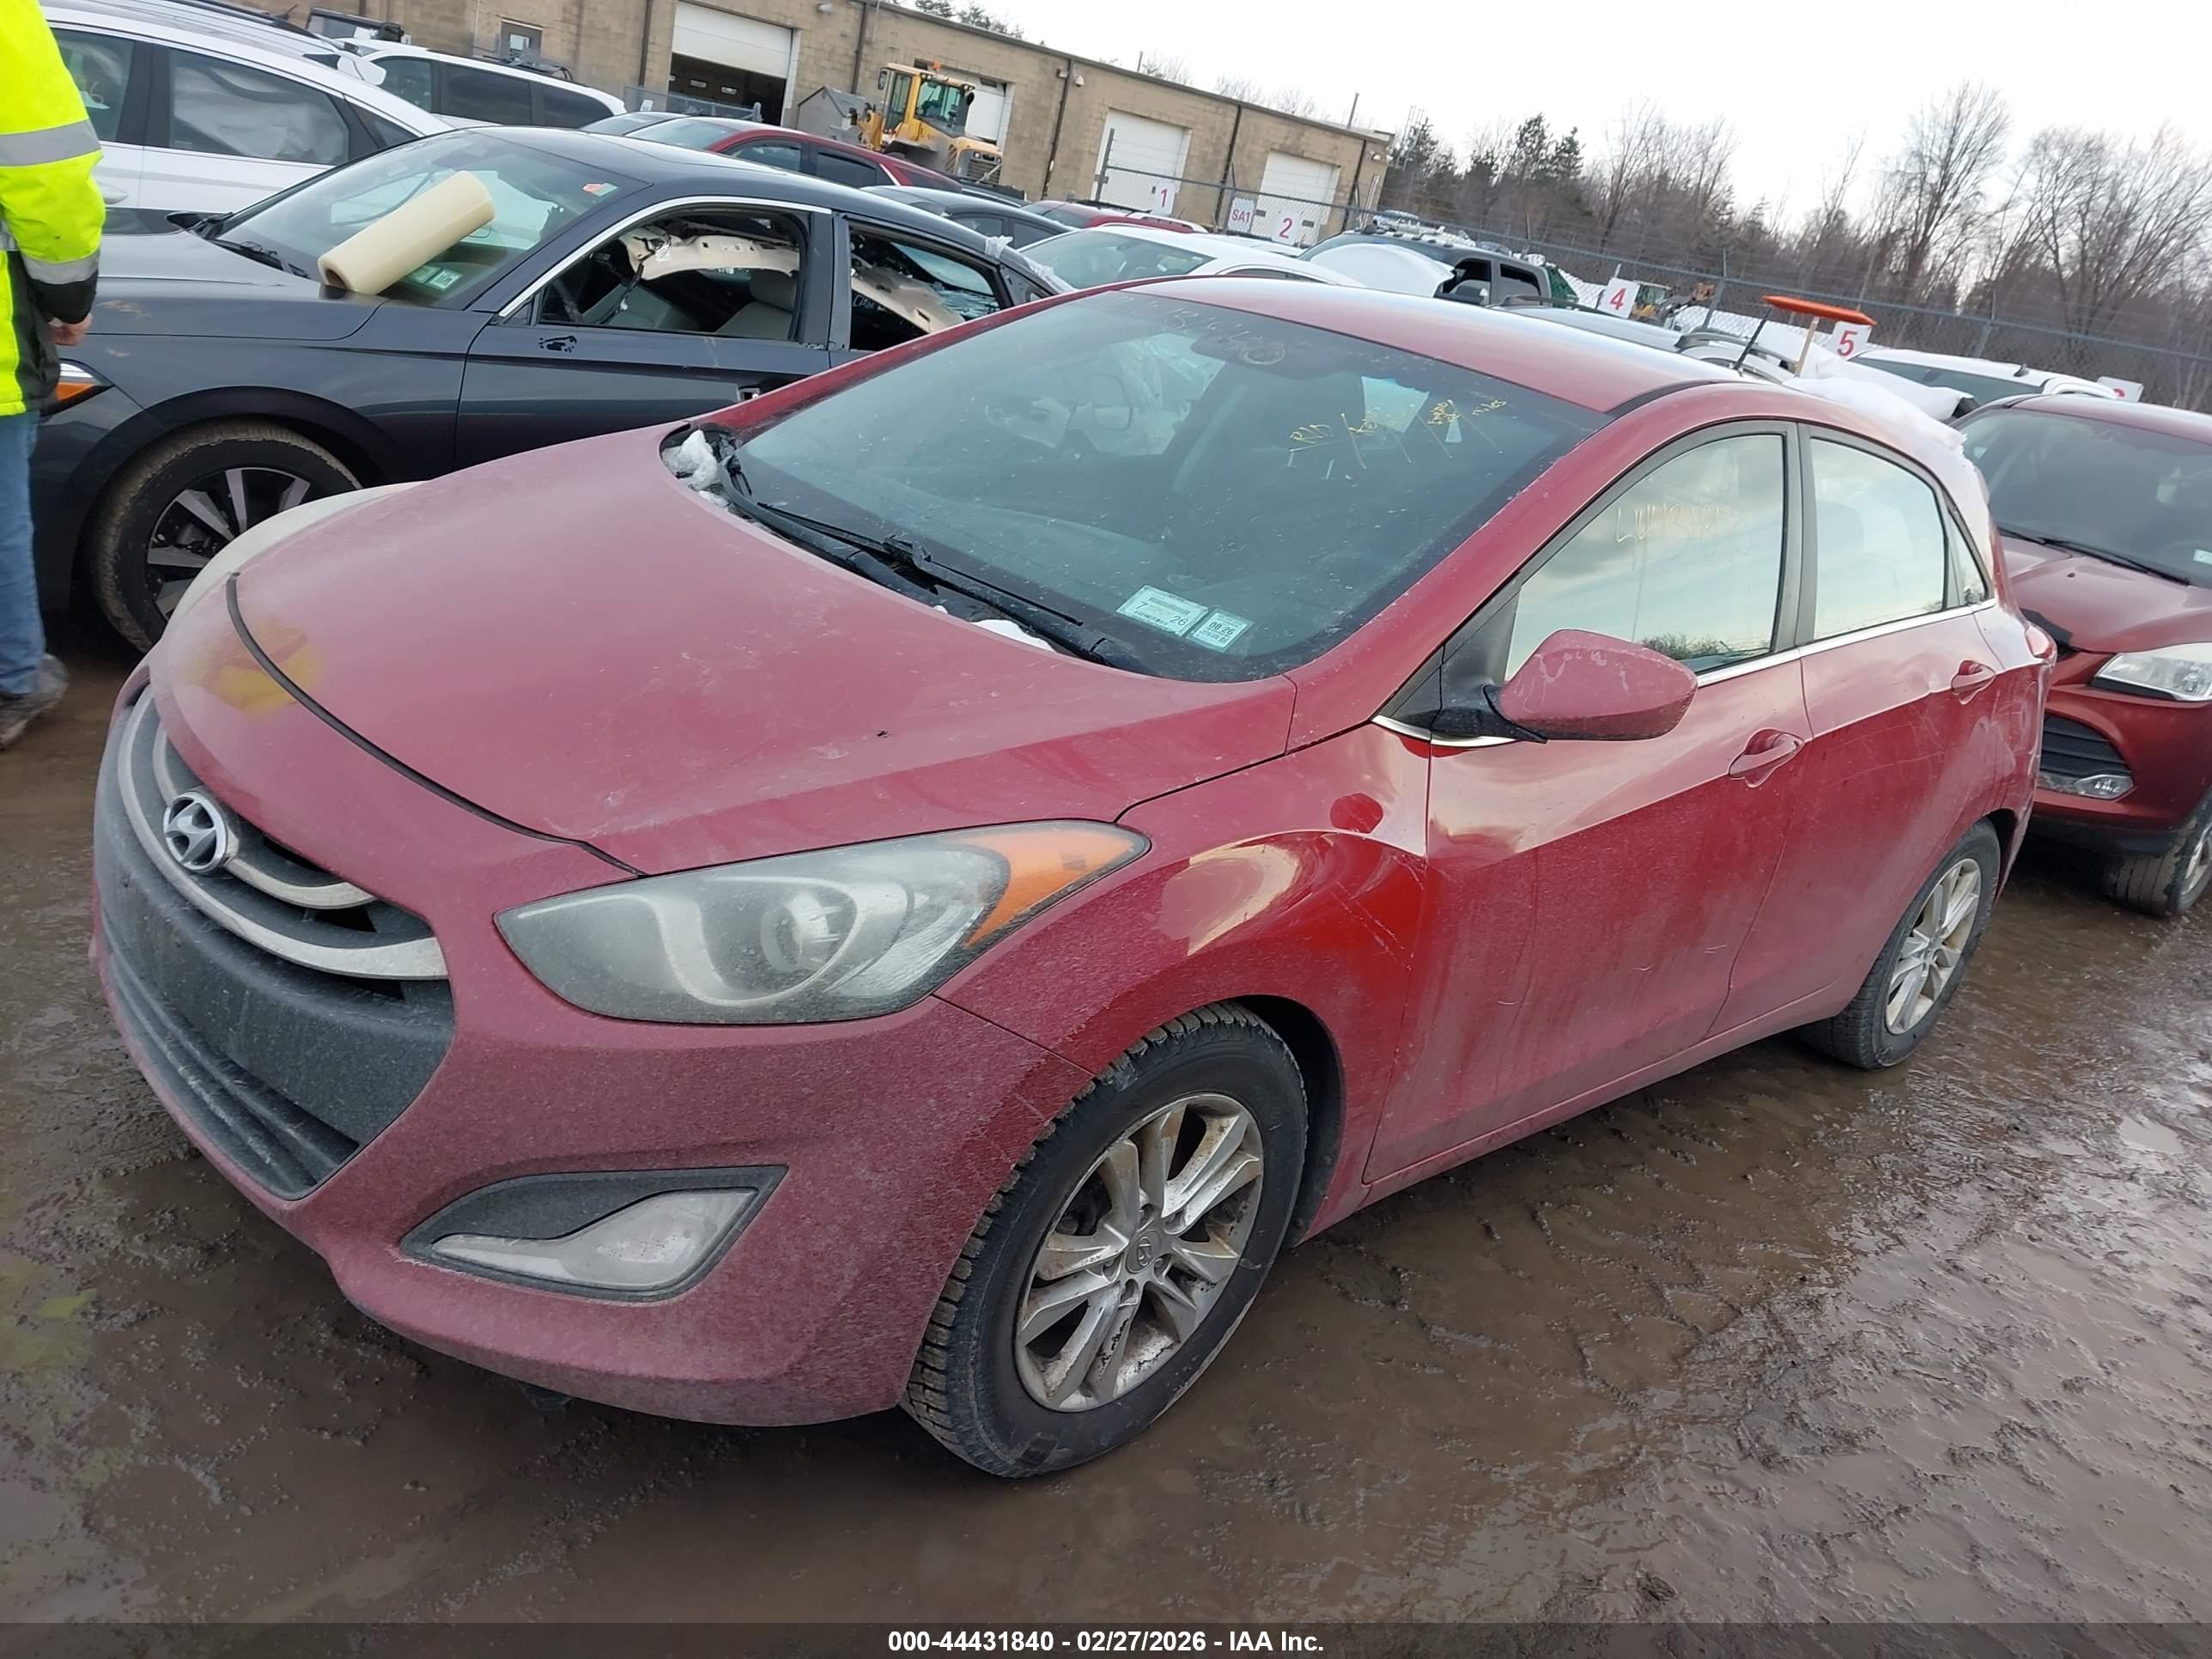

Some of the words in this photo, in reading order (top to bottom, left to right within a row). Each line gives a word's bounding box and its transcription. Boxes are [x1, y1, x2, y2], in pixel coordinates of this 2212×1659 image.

[1160, 188, 1169, 208] 1
[1231, 209, 1251, 224] SA1
[1278, 217, 1293, 239] 2
[1609, 288, 1627, 310] 4
[1837, 330, 1858, 356] 5
[1170, 615, 1189, 626] 26
